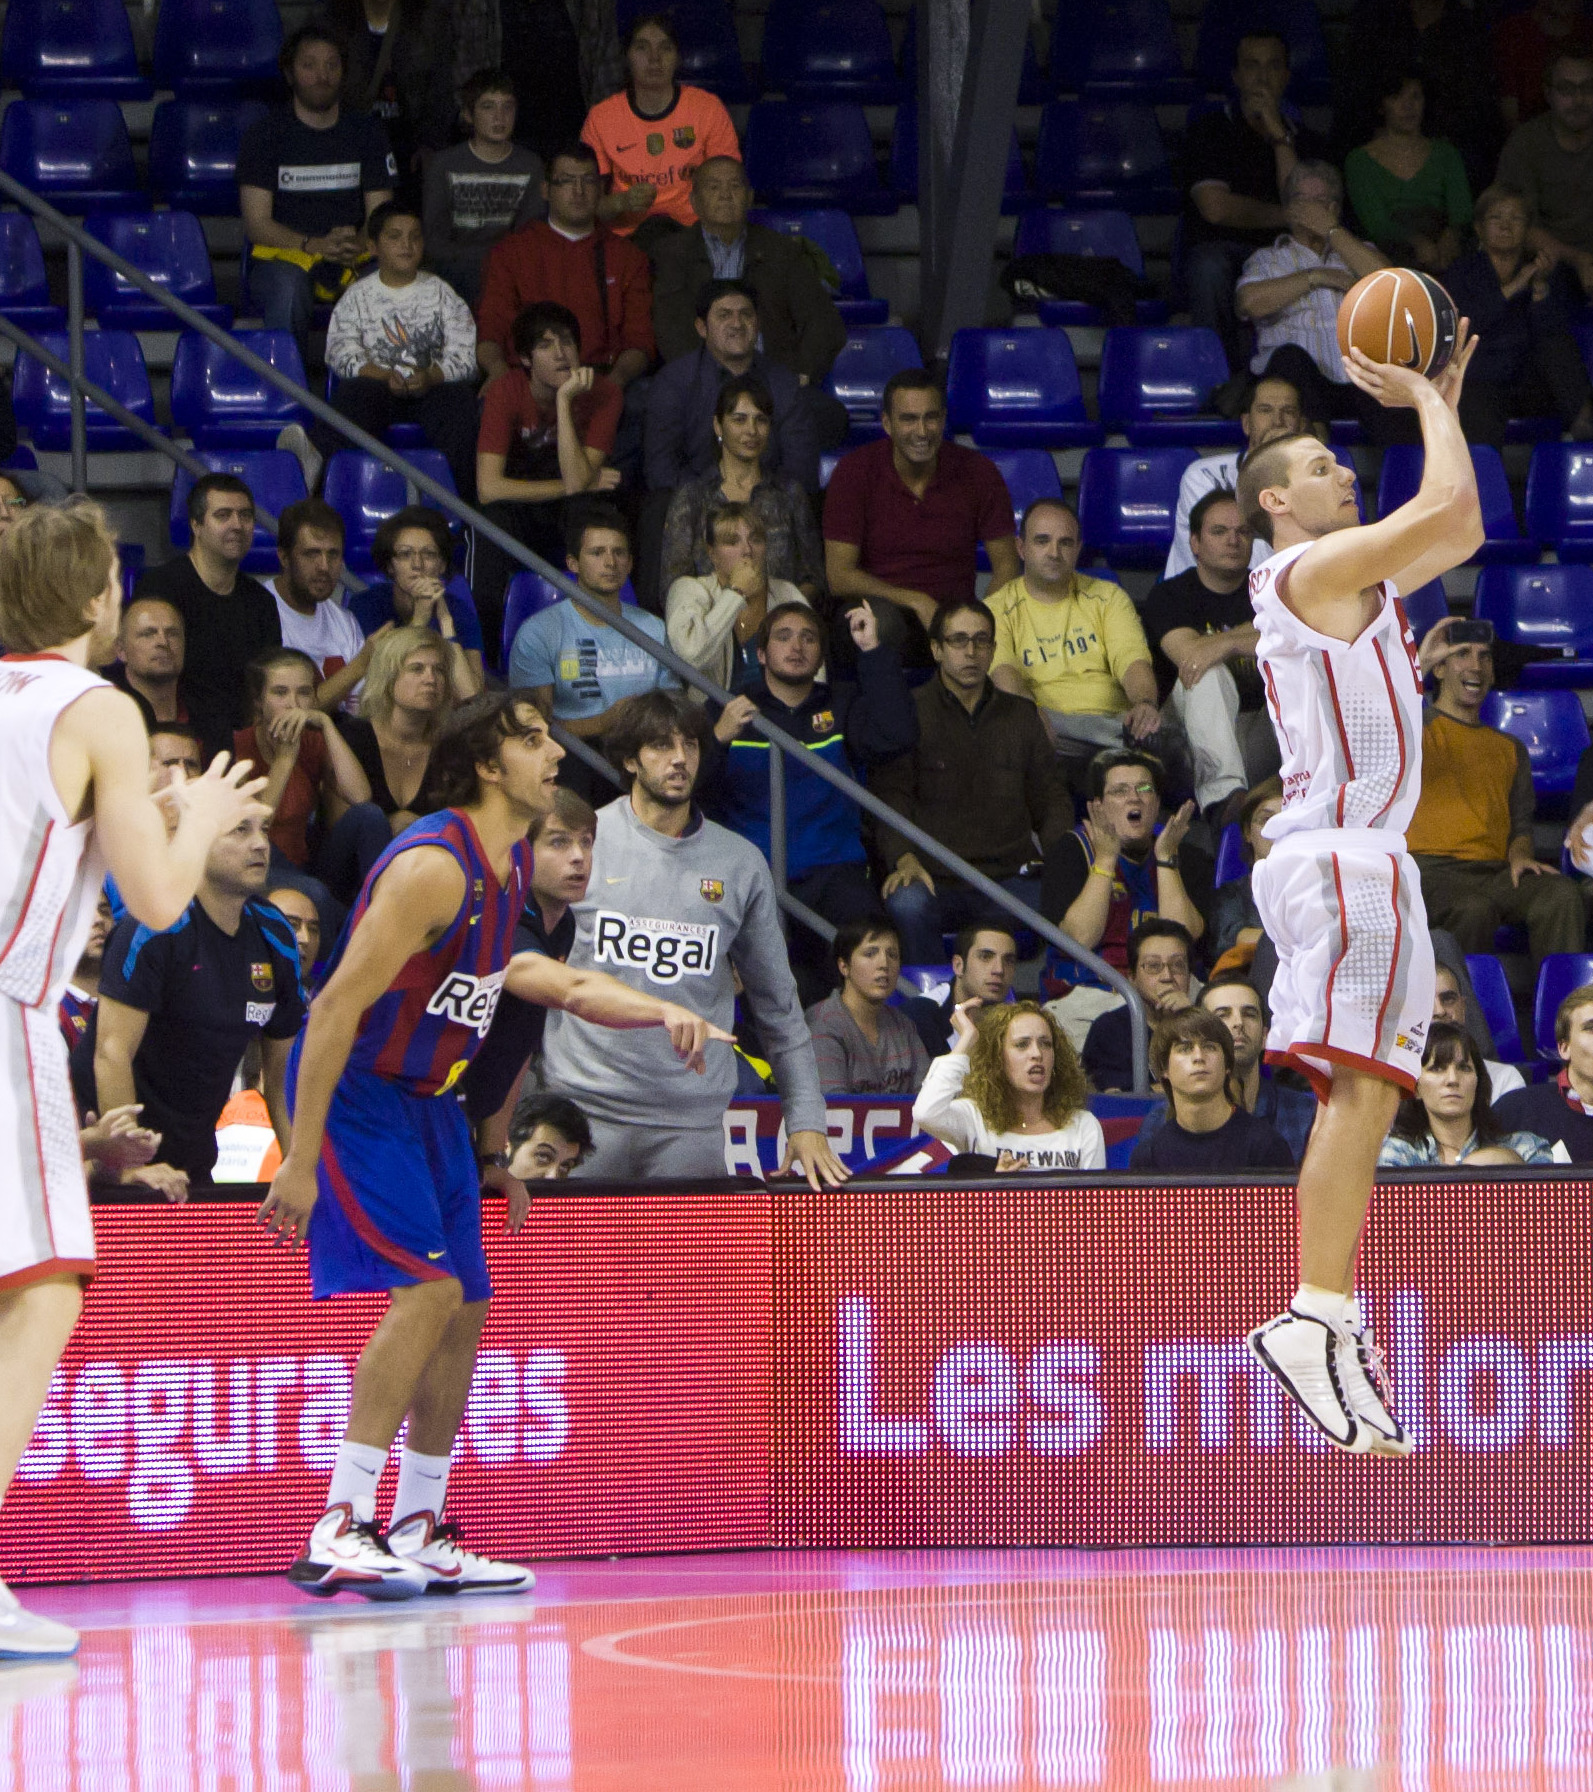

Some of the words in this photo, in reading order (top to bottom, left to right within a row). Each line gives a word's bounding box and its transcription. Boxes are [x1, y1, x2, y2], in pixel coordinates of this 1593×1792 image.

[597, 916, 715, 978] Regal
[630, 918, 708, 937] ASSEGURANCES
[837, 1295, 1103, 1457] Les
